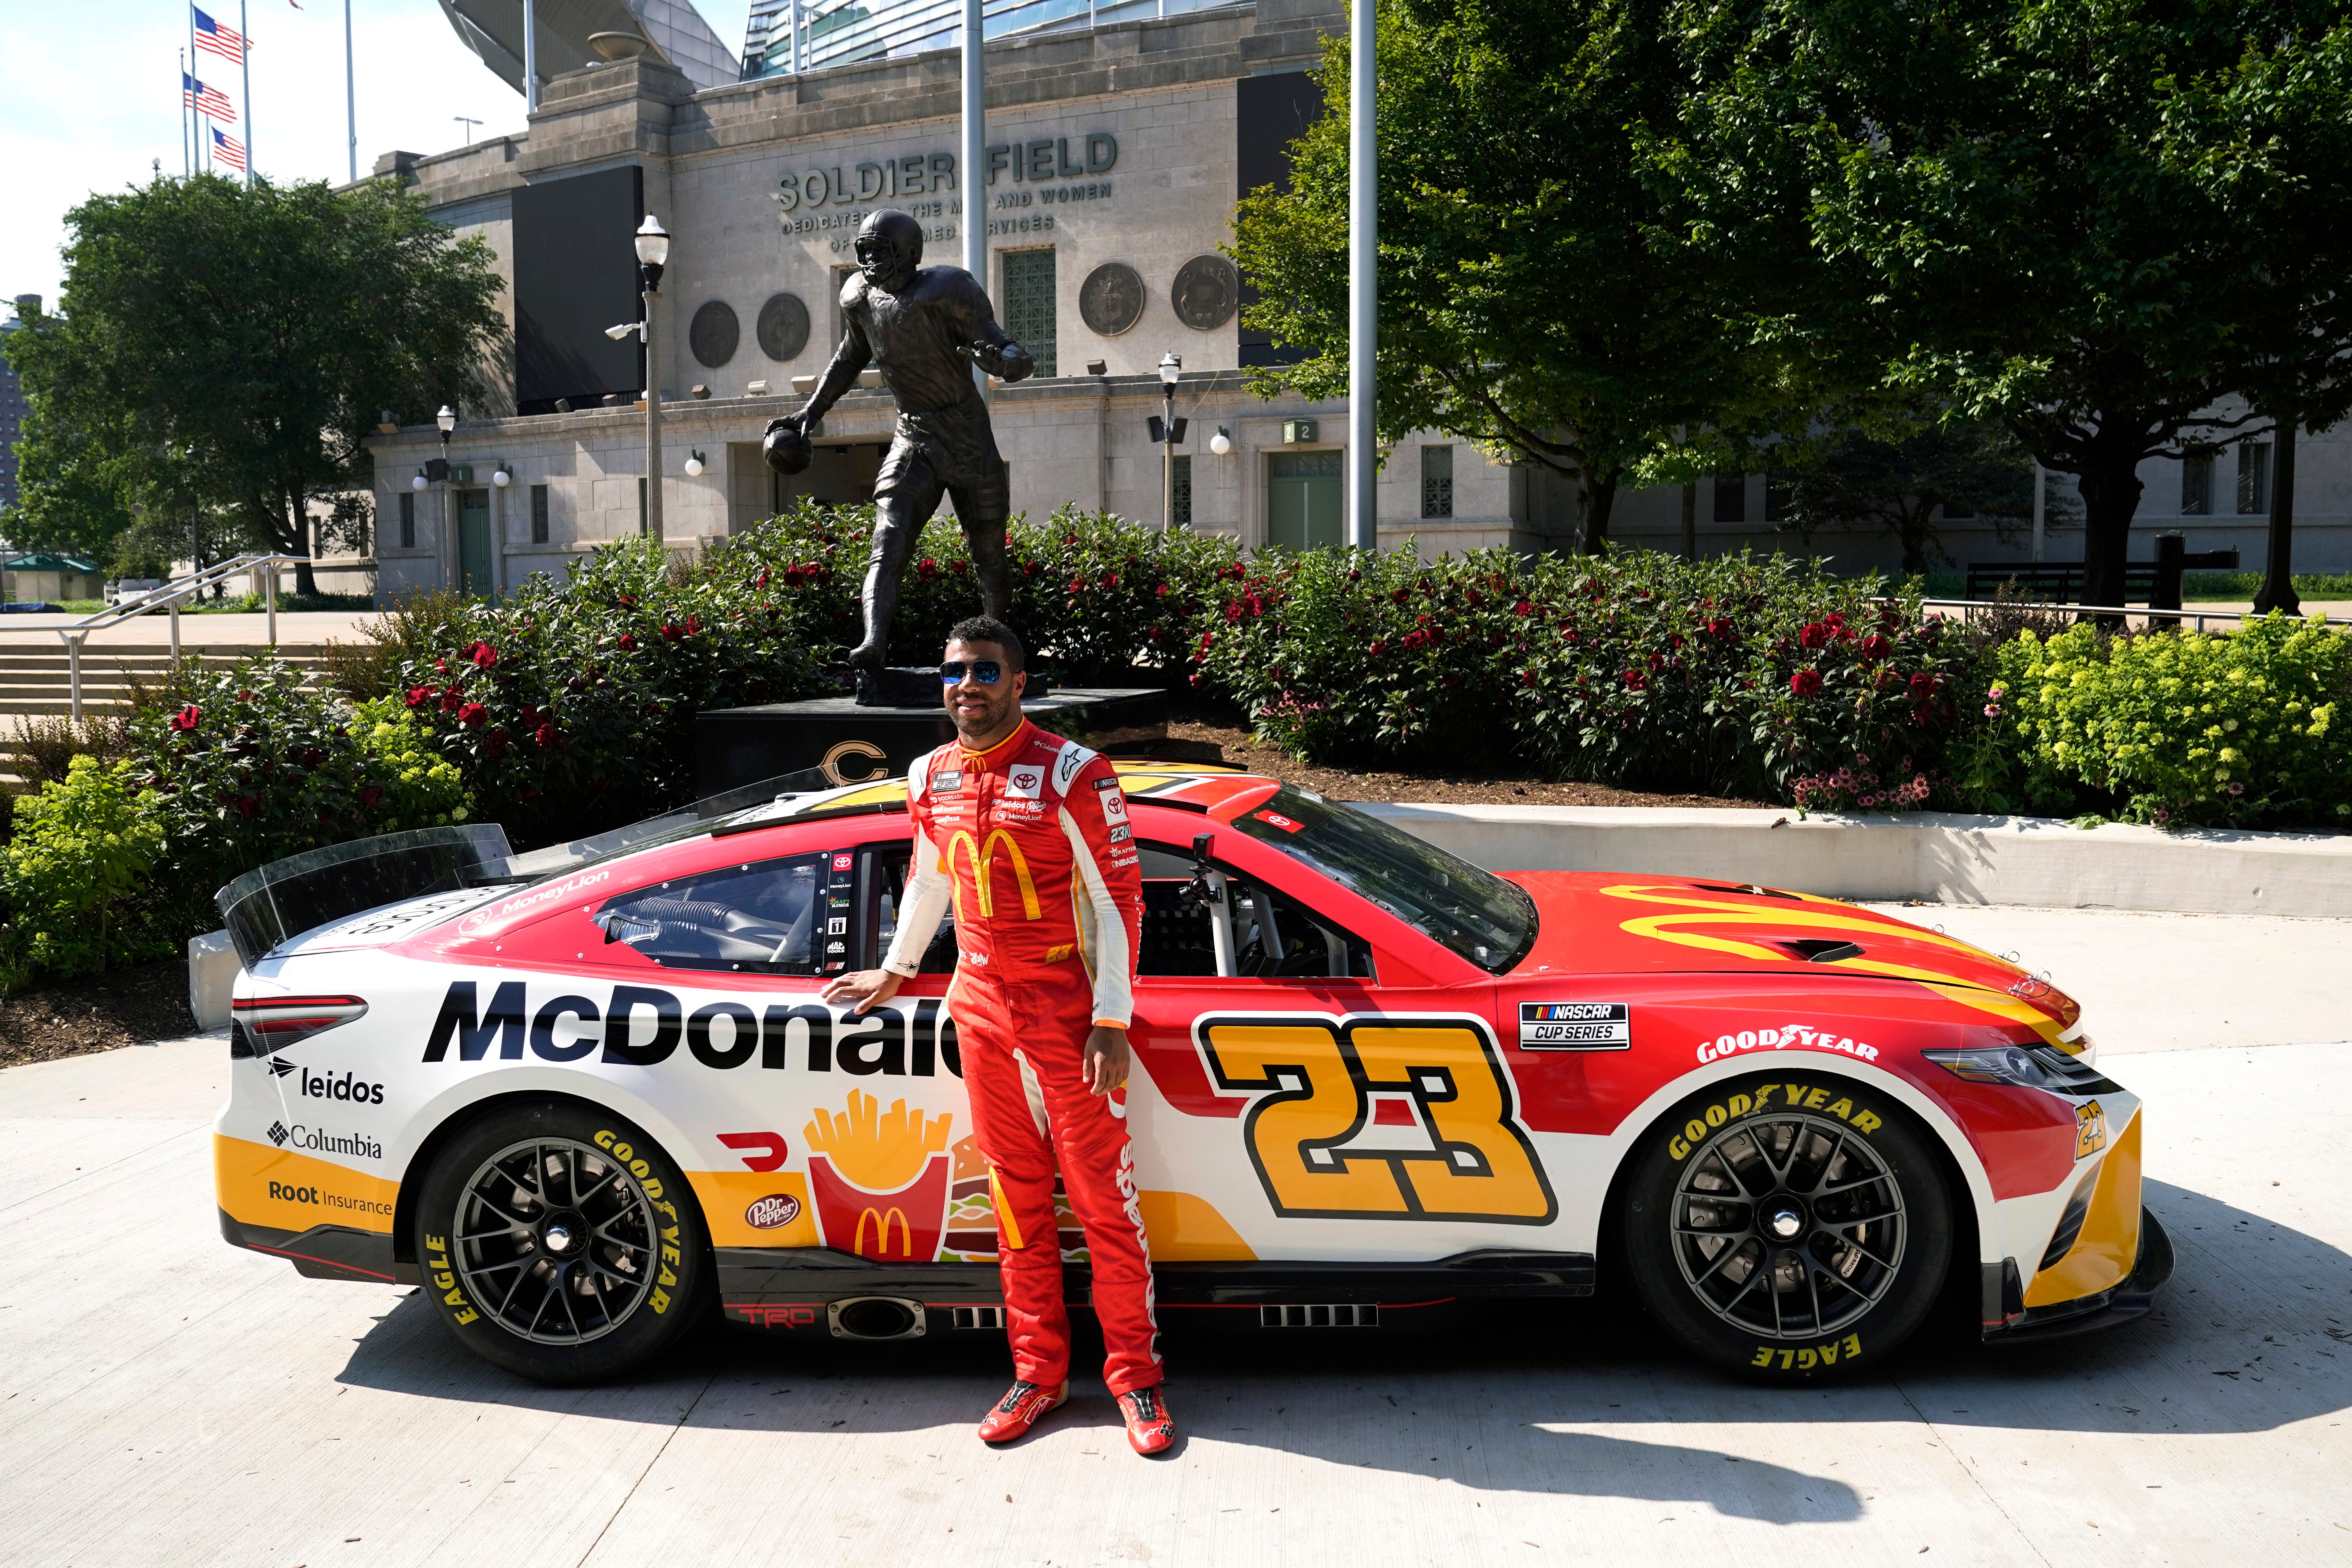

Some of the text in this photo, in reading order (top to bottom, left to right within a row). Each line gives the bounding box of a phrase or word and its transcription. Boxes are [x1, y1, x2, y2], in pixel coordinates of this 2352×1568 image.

[776, 133, 1117, 211] SOLDIER FIELD
[910, 203, 941, 218] THE
[995, 192, 1031, 209] AND
[1041, 183, 1111, 204] WOMEN
[831, 215, 1054, 252] OF MED RVICES
[1286, 426, 1291, 439] 2
[1302, 425, 1309, 438] 2
[1110, 823, 1132, 844] 23XI
[502, 870, 609, 915] MoneyLion
[835, 923, 839, 932] 1
[827, 941, 845, 951] MAC
[1045, 943, 1074, 964] 23
[825, 962, 845, 970] 23XI
[1554, 1005, 1612, 1019] NASCAR
[1535, 1026, 1613, 1039] CUP SERIES
[302, 1067, 384, 1105] leidos
[1196, 1017, 1559, 1227] 23
[2075, 1099, 2106, 1161] 23
[290, 1125, 382, 1159] Columbia
[269, 1181, 392, 1216] Root Insurance
[765, 1198, 783, 1213] Dr
[753, 1202, 794, 1226] Pepper
[1843, 1258, 1857, 1276] RACING
[426, 1234, 480, 1325] EAGLE
[739, 1308, 815, 1329] TRD
[1751, 1333, 1862, 1370] EAGLE
